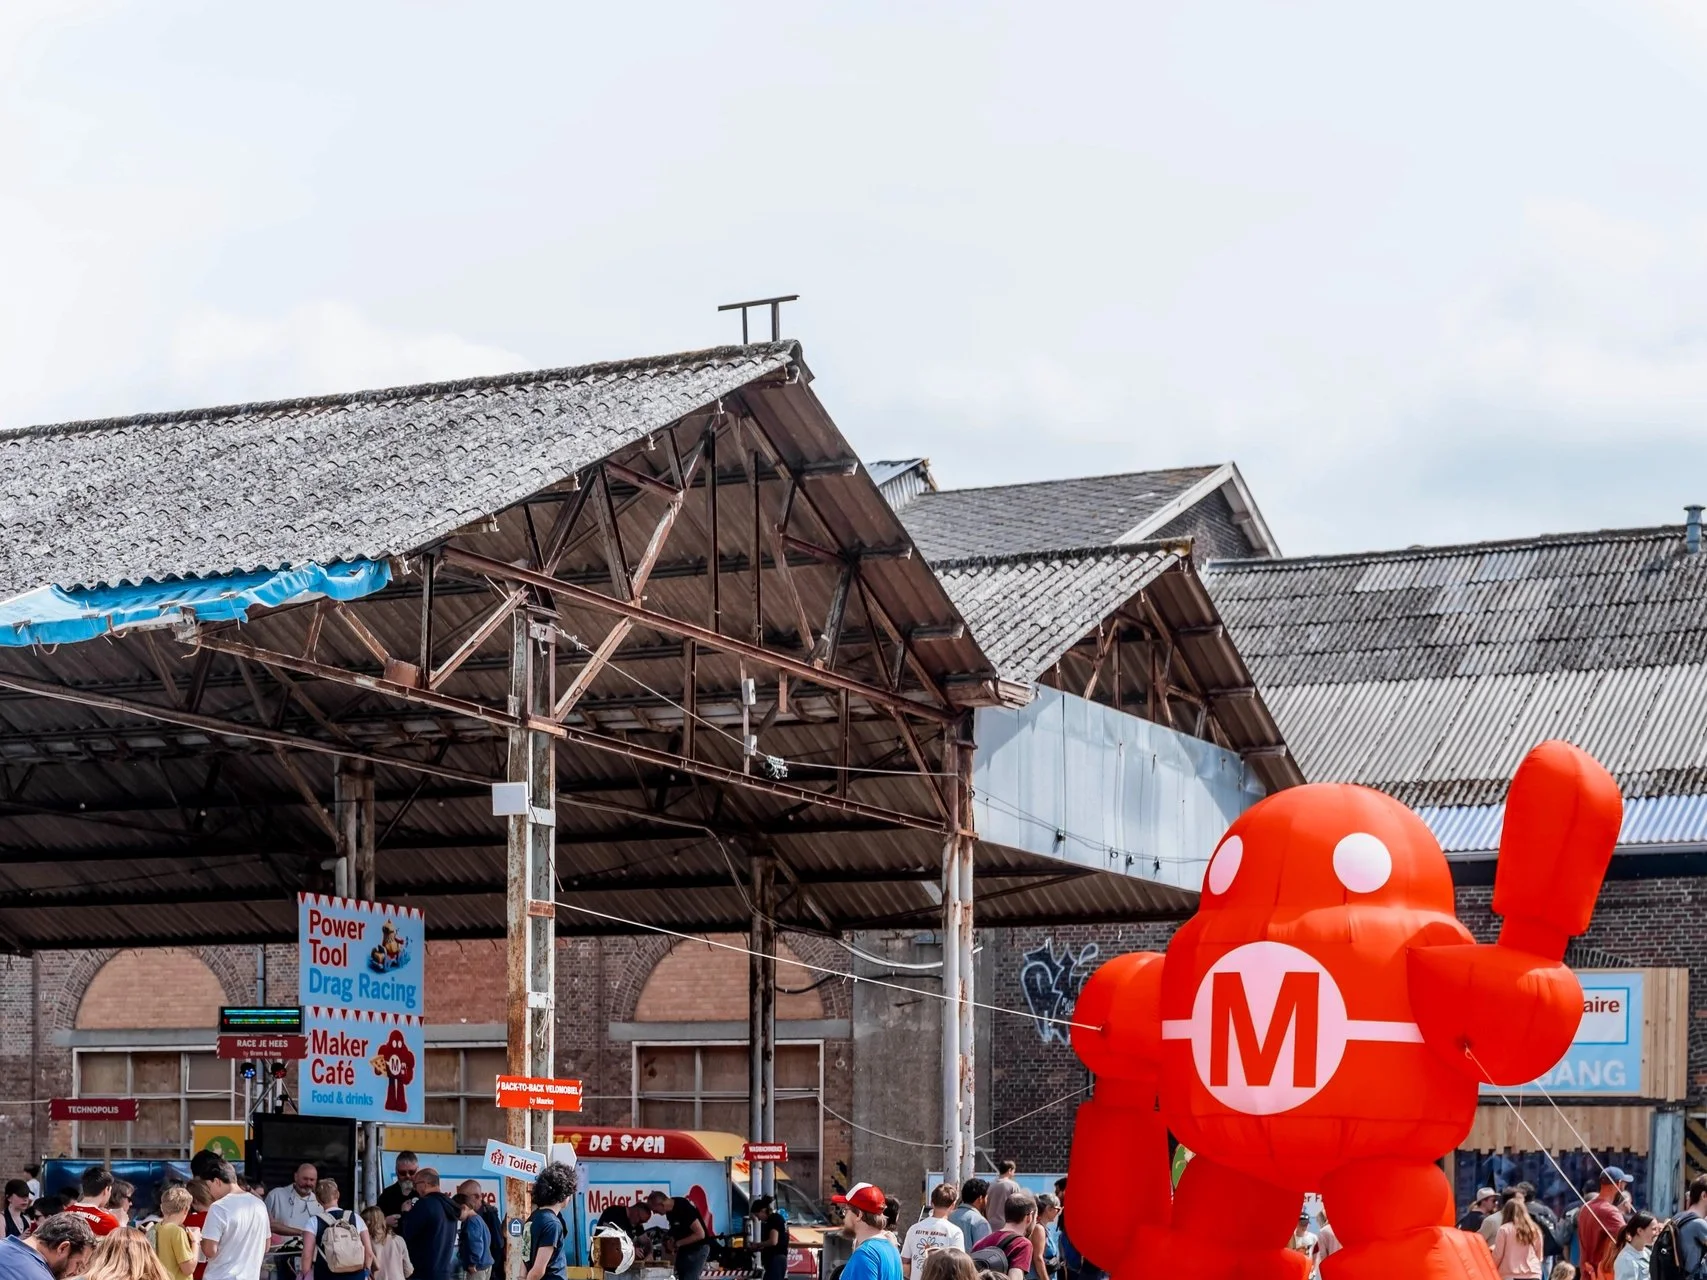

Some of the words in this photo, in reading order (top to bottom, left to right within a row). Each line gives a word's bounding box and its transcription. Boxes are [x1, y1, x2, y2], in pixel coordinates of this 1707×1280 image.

[309, 909, 365, 940] Power
[309, 938, 347, 967] Tool
[309, 967, 353, 1003] Drag
[359, 972, 417, 1009] Racing
[1583, 996, 1620, 1013] aire
[312, 1029, 368, 1057] Maker
[1210, 972, 1320, 1088] M
[311, 1059, 354, 1086] Café
[312, 1090, 334, 1103] Food
[336, 1091, 344, 1104] &
[346, 1093, 374, 1105] drinks
[501, 1082, 544, 1092] BACK-TO-BACK
[546, 1085, 579, 1094] VELOMOBIEL
[509, 1155, 537, 1173] Toilet
[588, 1190, 632, 1213] Maker
